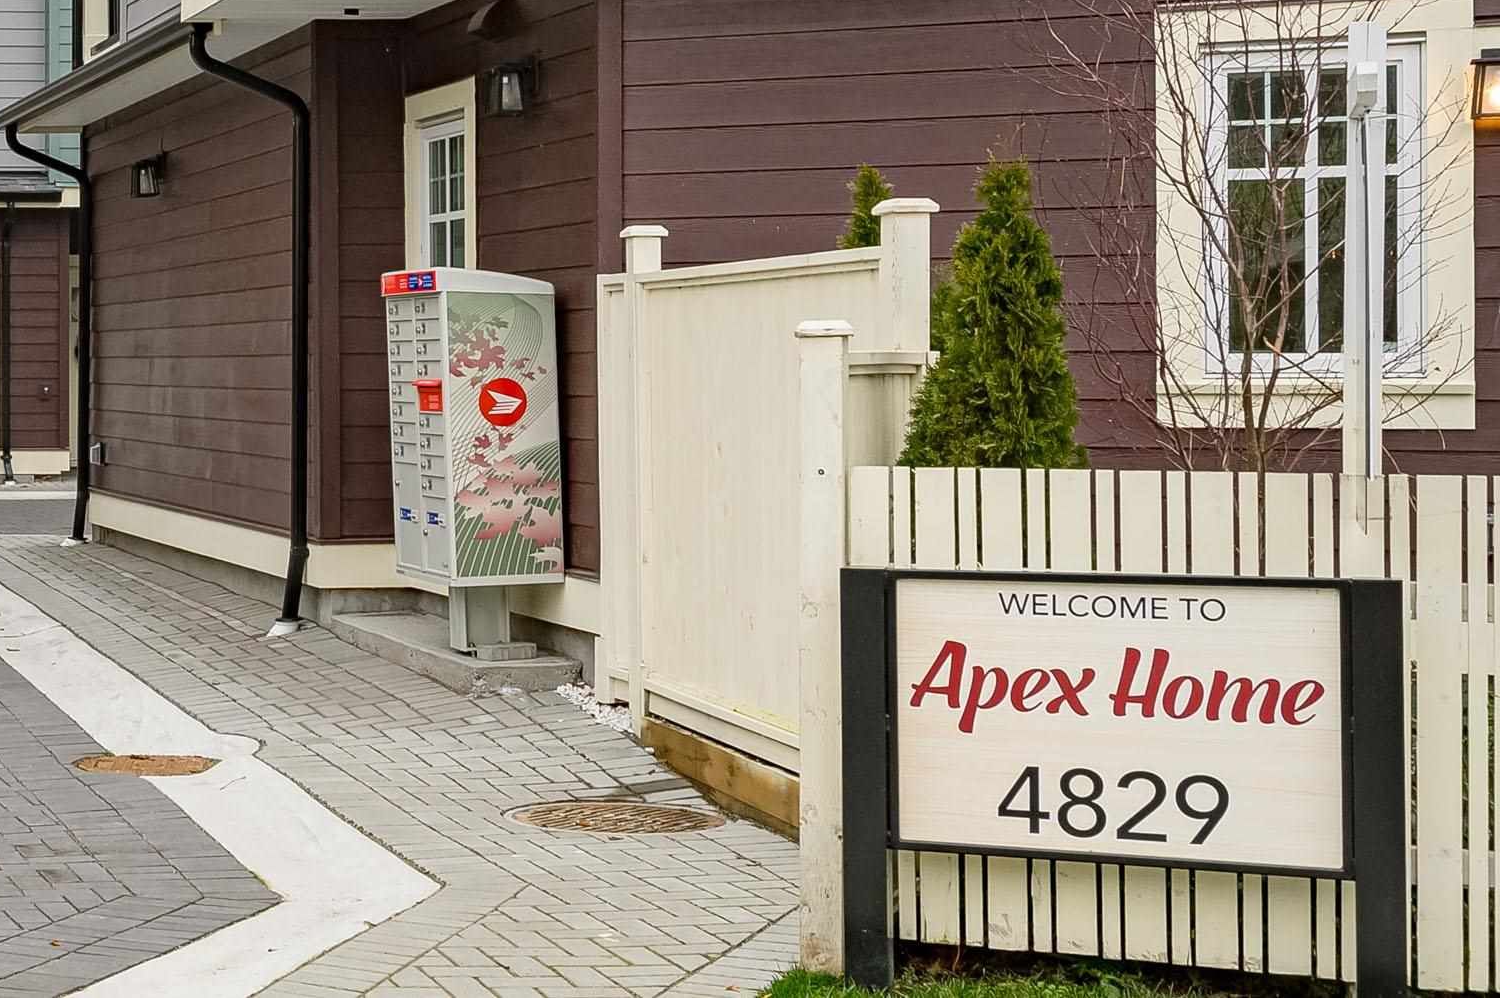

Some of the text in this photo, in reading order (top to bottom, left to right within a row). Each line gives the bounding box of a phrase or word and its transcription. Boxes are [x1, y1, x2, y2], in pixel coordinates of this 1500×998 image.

[998, 592, 1226, 622] WELCOME TO
[909, 640, 1325, 734] Apex Home
[997, 766, 1230, 845] 4829
